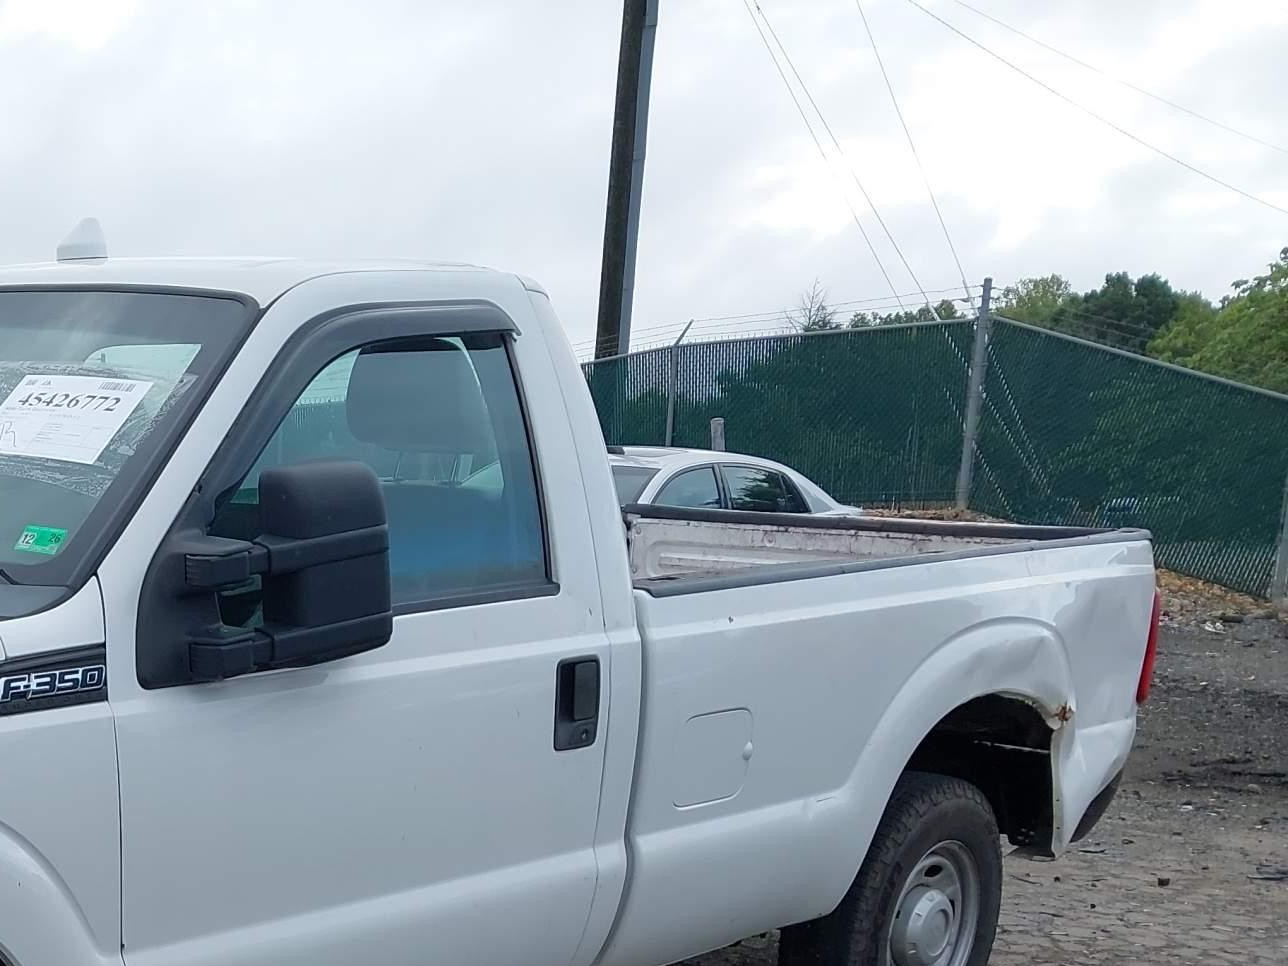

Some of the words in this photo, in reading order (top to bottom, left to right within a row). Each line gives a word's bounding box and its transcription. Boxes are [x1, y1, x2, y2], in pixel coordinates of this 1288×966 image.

[18, 392, 121, 412] 45426772
[21, 533, 36, 545] 12
[48, 533, 62, 544] 26
